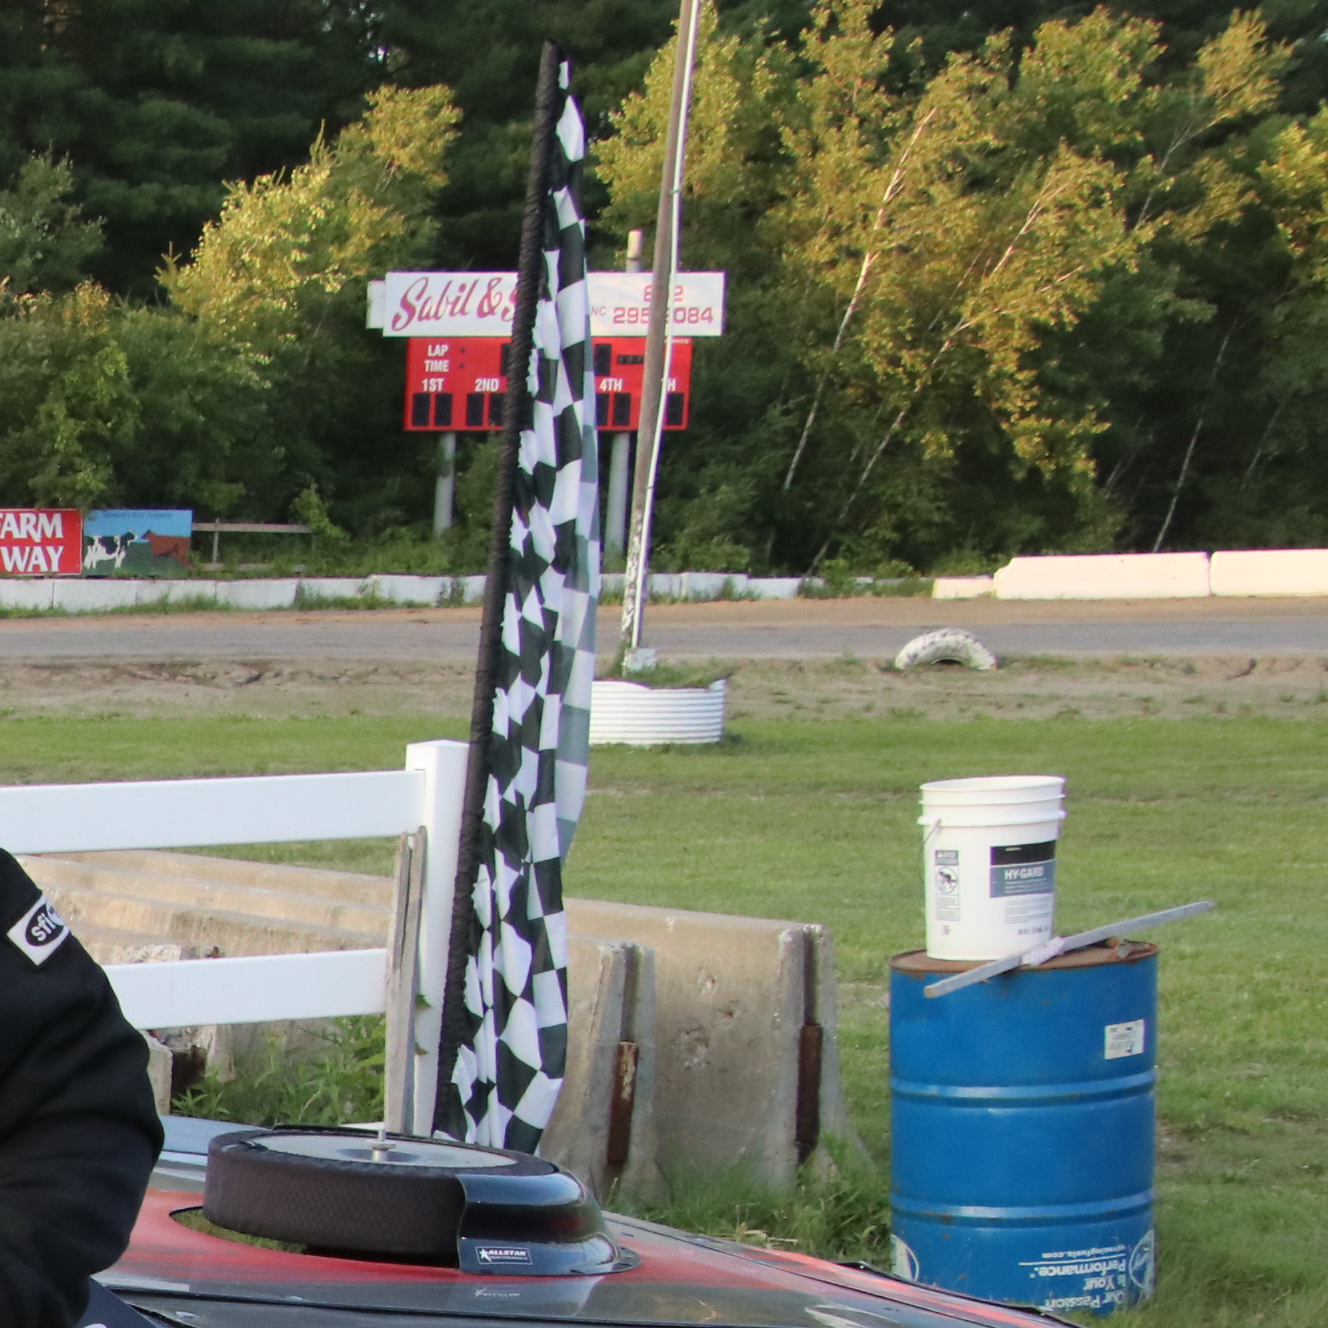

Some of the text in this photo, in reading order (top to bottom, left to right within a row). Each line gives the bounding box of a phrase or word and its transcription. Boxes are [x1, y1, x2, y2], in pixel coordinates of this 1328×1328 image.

[476, 276, 504, 315] &
[427, 344, 449, 358] LAP
[424, 360, 450, 373] TIME
[421, 378, 500, 393] 1ST 2ND
[599, 377, 623, 392] 4TH
[0, 546, 65, 573] WAY
[1083, 1275, 1116, 1290] Your
[1045, 1294, 1101, 1309] Passion
